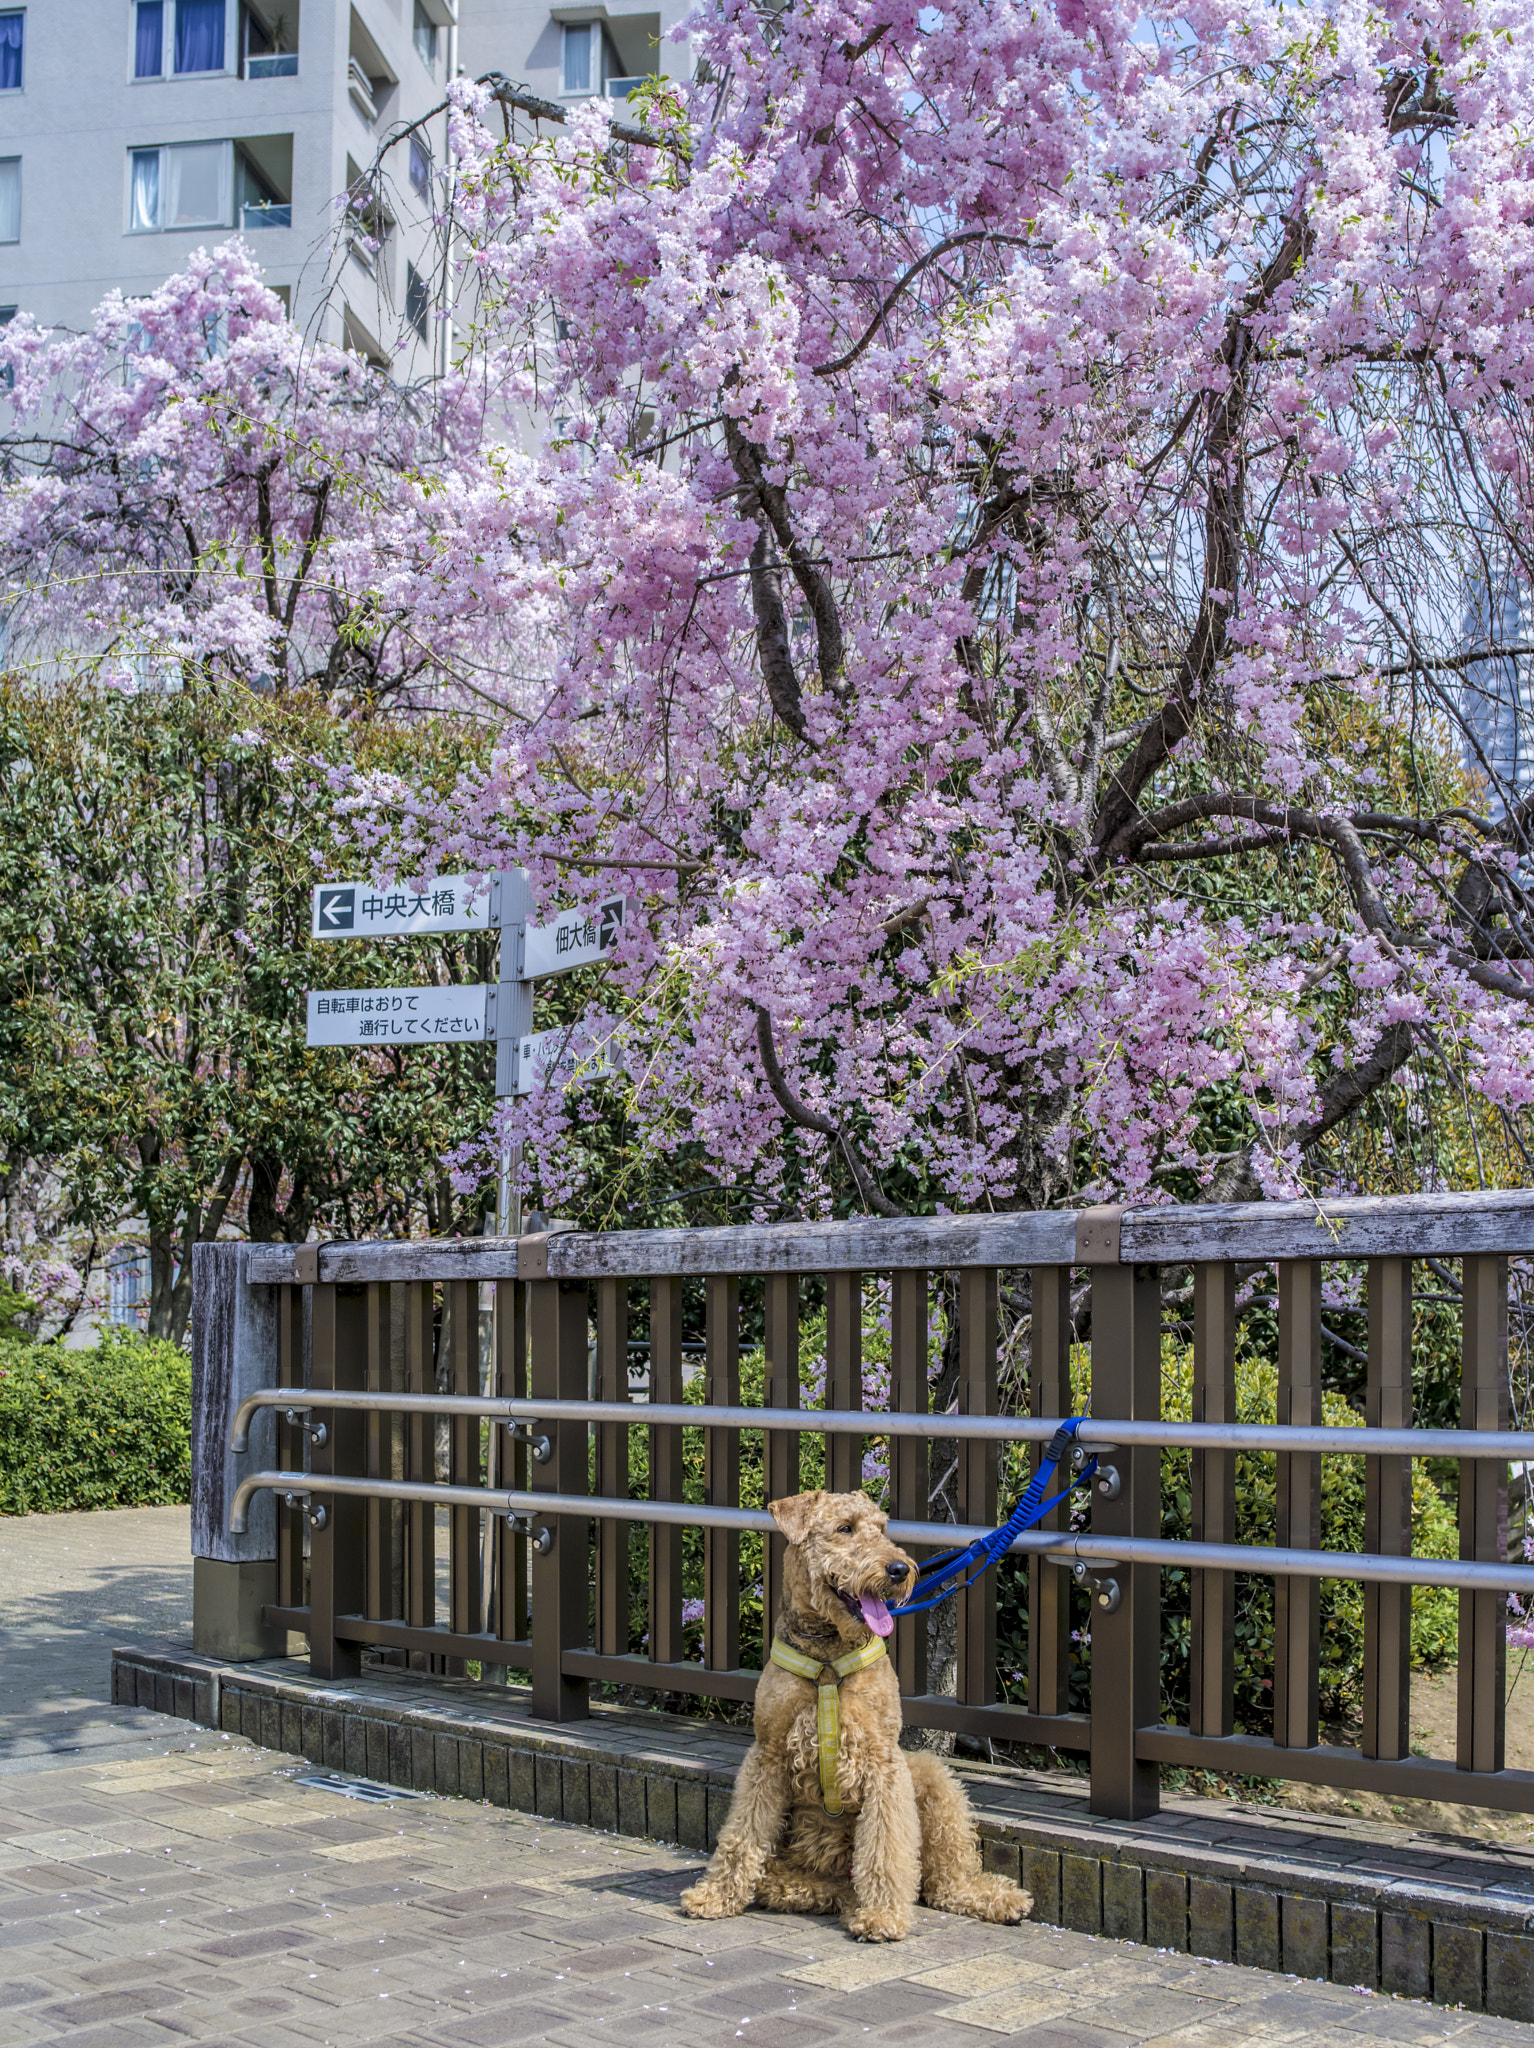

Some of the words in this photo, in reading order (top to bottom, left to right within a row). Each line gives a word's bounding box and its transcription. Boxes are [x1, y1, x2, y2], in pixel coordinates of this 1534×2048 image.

[362, 889, 455, 920] 中央大橋
[556, 921, 596, 954] 佃大橋
[317, 996, 419, 1015] 自転車はおりて
[359, 1018, 479, 1036] 通行してください
